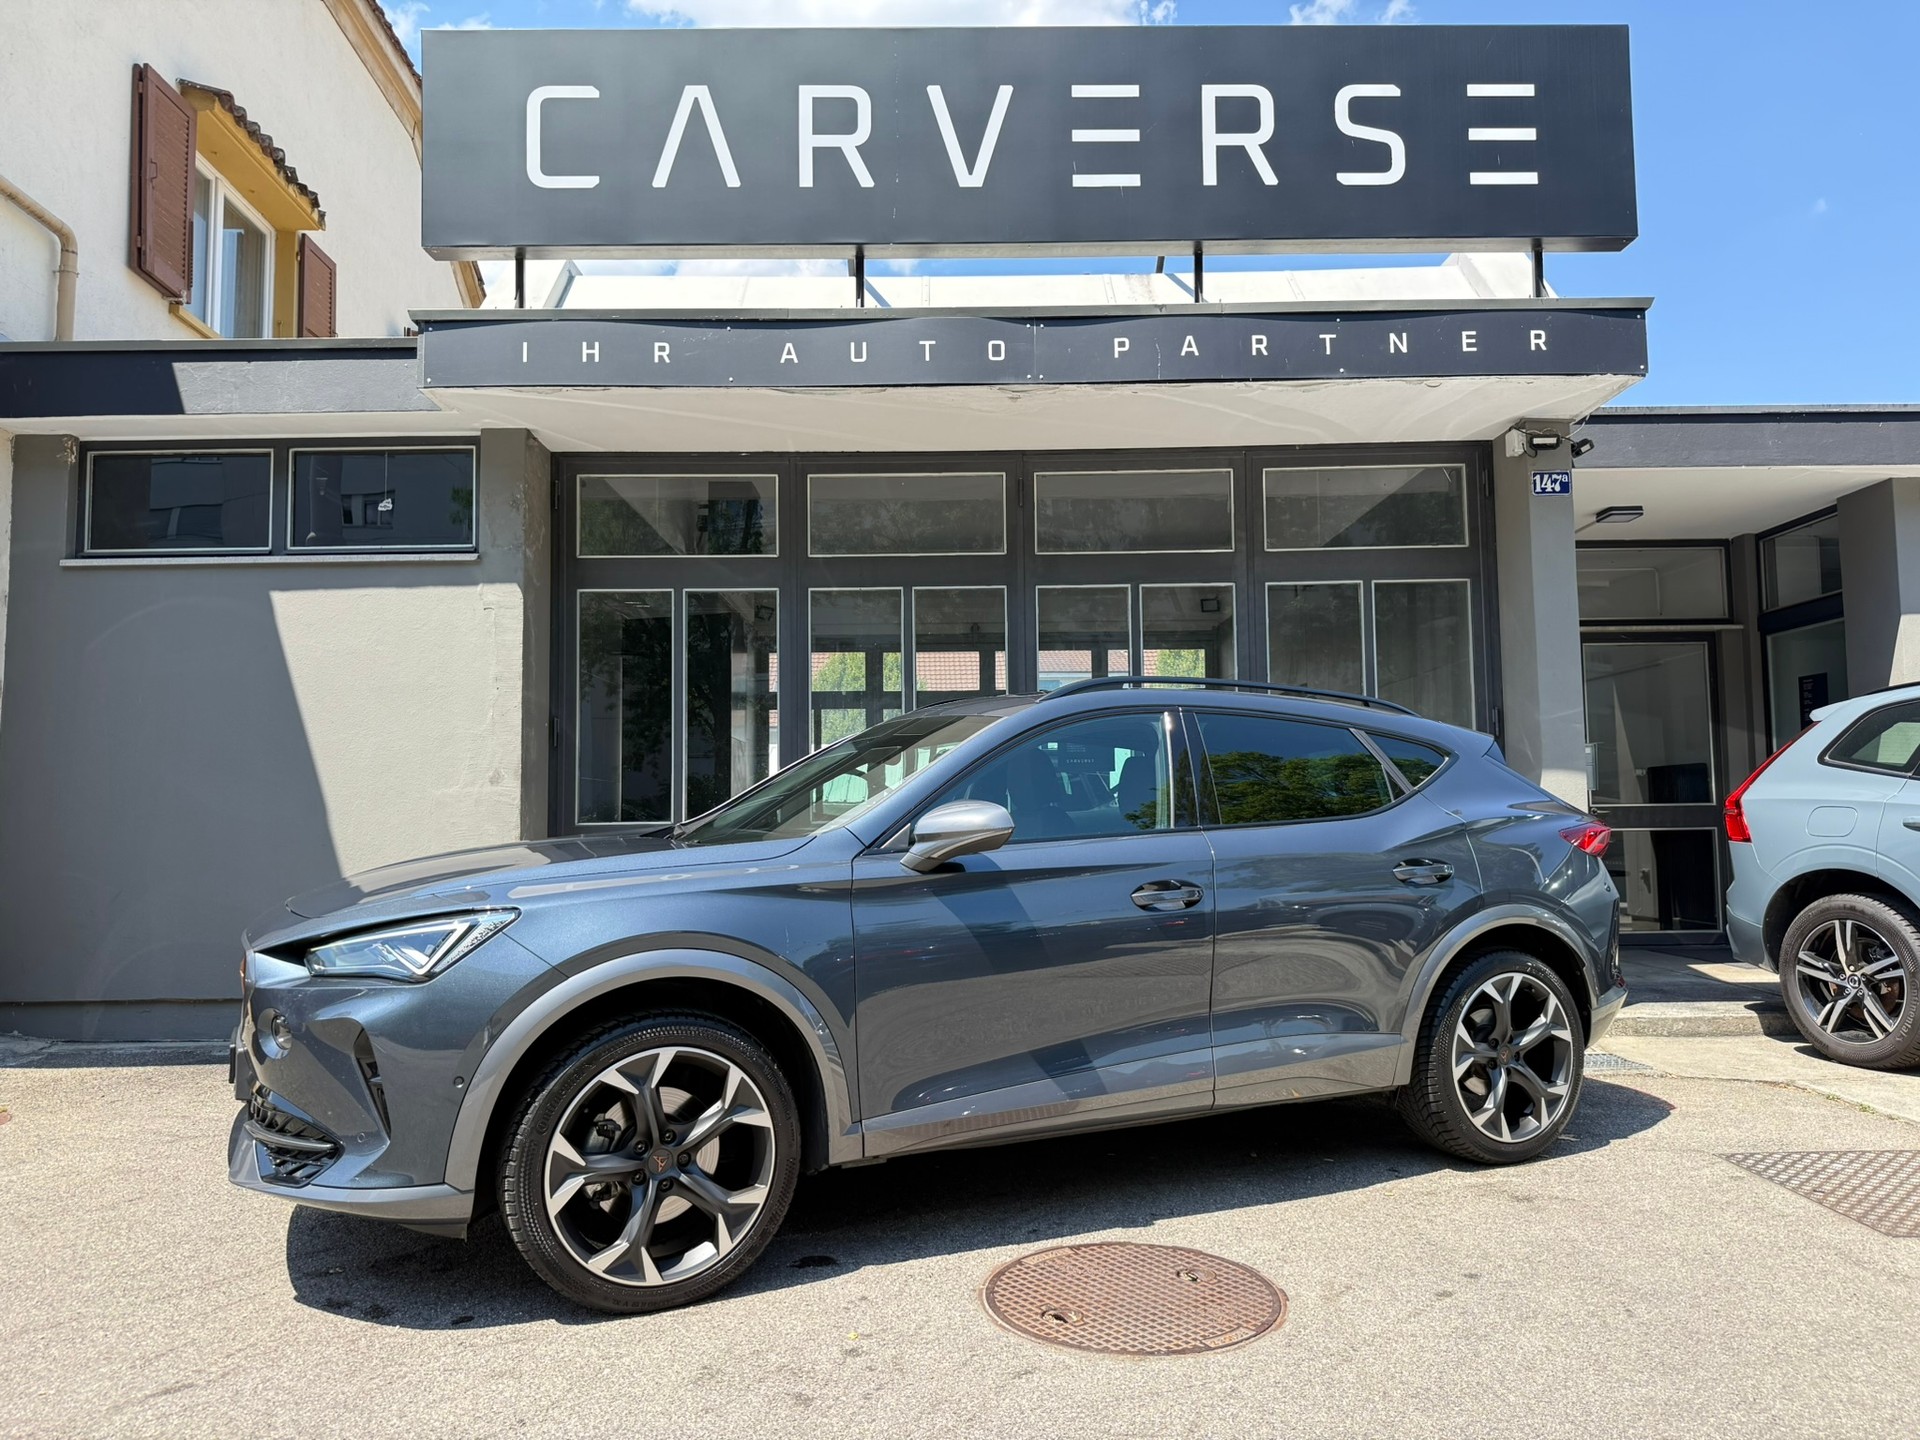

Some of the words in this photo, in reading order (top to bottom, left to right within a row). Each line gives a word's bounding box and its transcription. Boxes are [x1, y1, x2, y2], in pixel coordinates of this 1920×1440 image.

[525, 84, 1539, 190] CARVERSE
[522, 341, 671, 363] IHR
[780, 340, 1006, 364] AUTO
[1113, 330, 1548, 359] PARTNER
[1533, 473, 1569, 493] 147a
